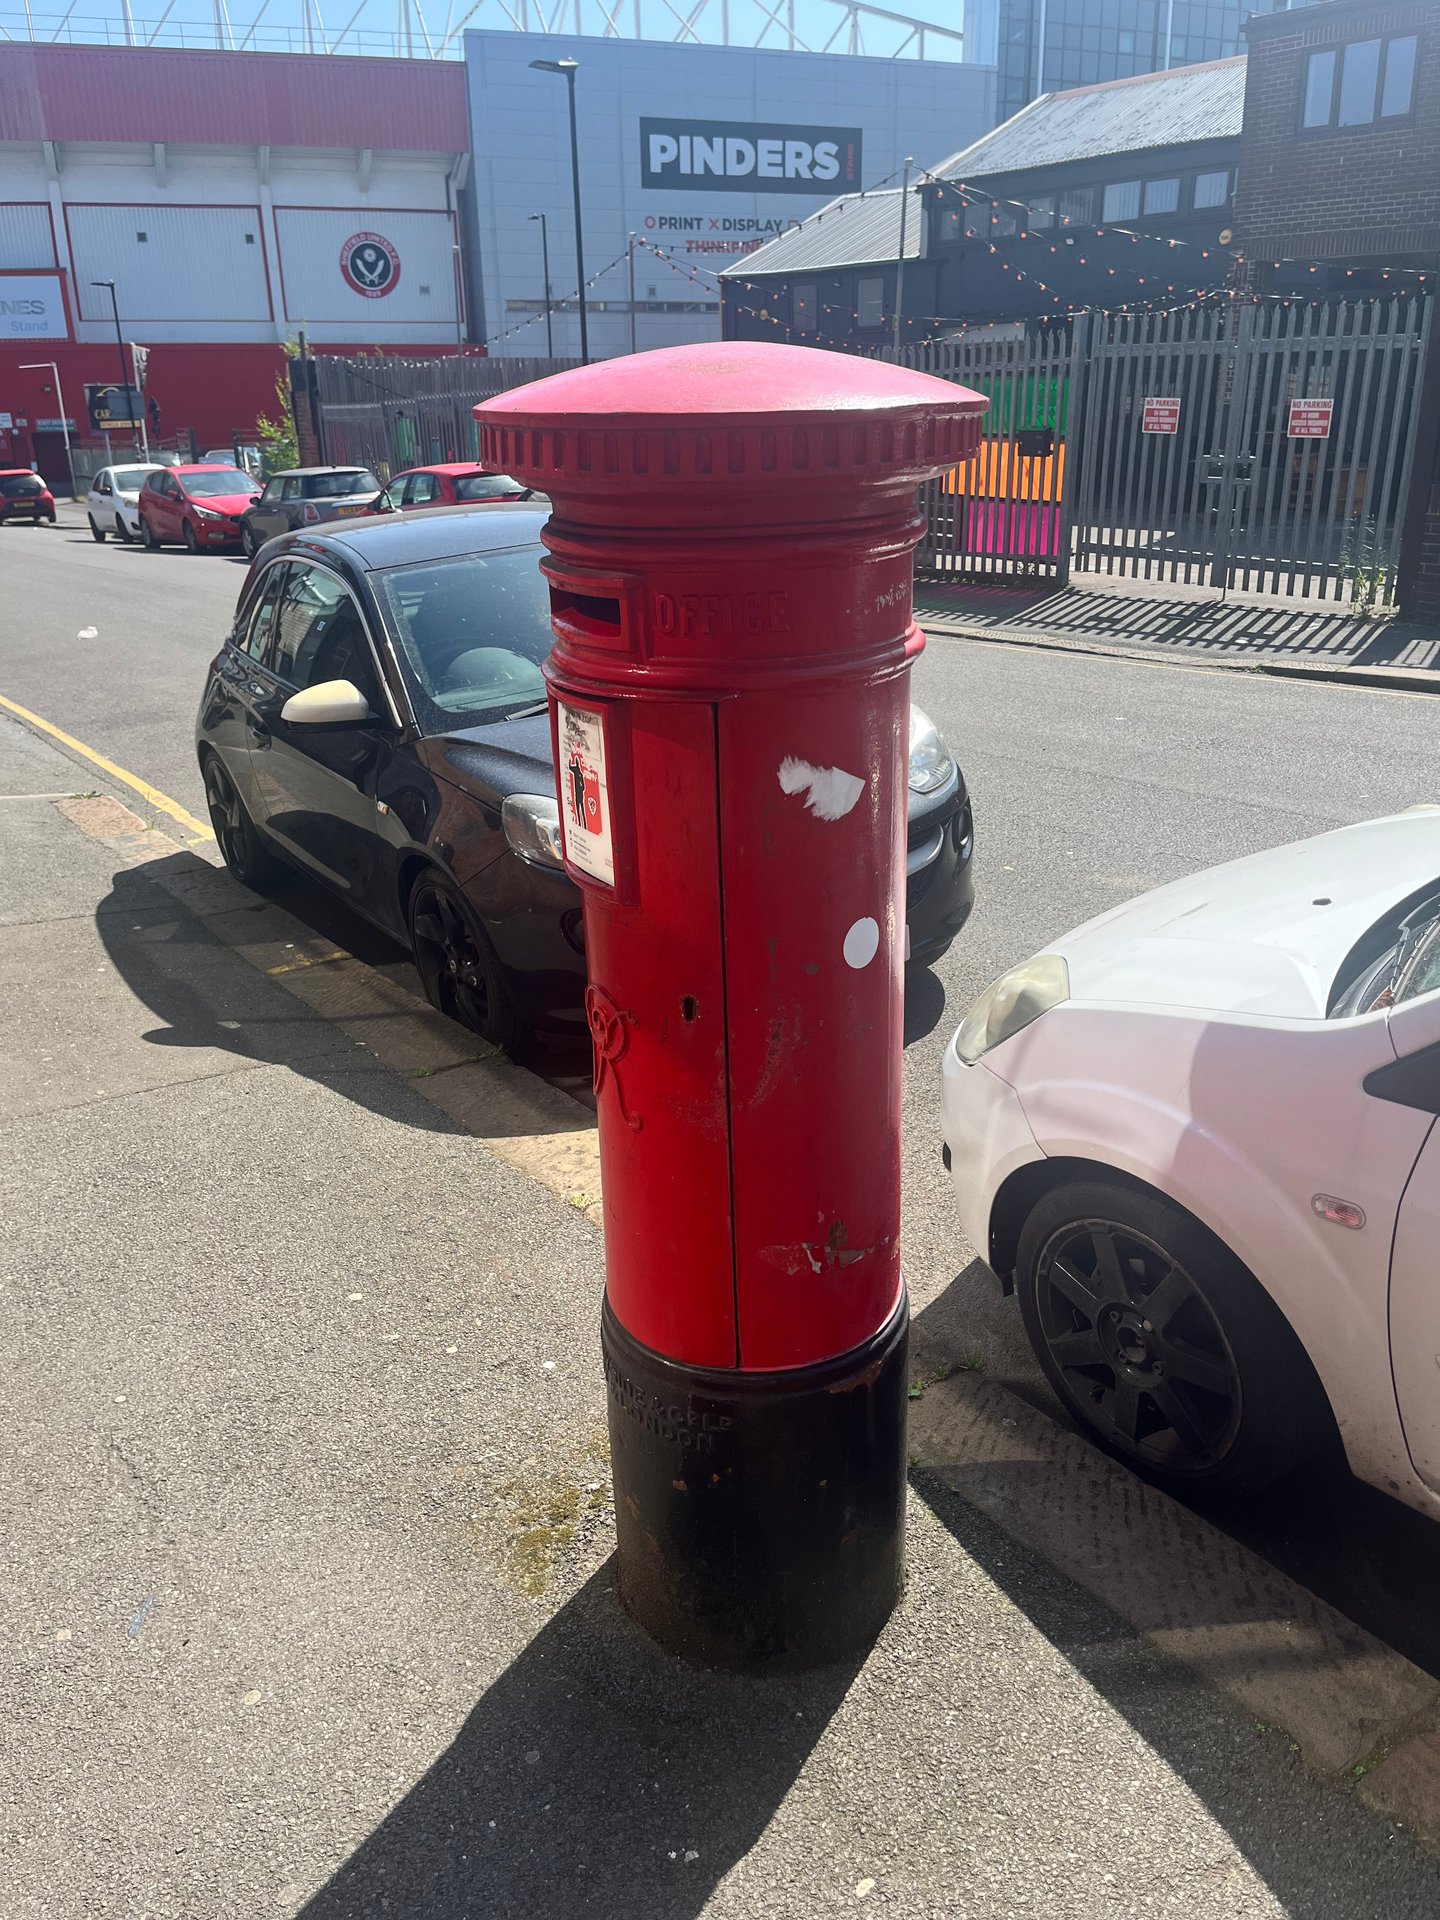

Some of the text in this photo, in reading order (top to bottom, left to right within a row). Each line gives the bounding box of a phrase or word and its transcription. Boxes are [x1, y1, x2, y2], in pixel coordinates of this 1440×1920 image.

[649, 134, 840, 180] PINDERS
[658, 216, 783, 232] PRINT DISPLAY
[341, 233, 367, 266] SHEFFIELD
[367, 233, 393, 252] UNITED
[0, 300, 45, 315] NES
[11, 321, 48, 332] Stand
[1146, 399, 1180, 407] NO PARKING
[1292, 400, 1332, 409] NO PARKING
[655, 591, 788, 637] OFFICE
